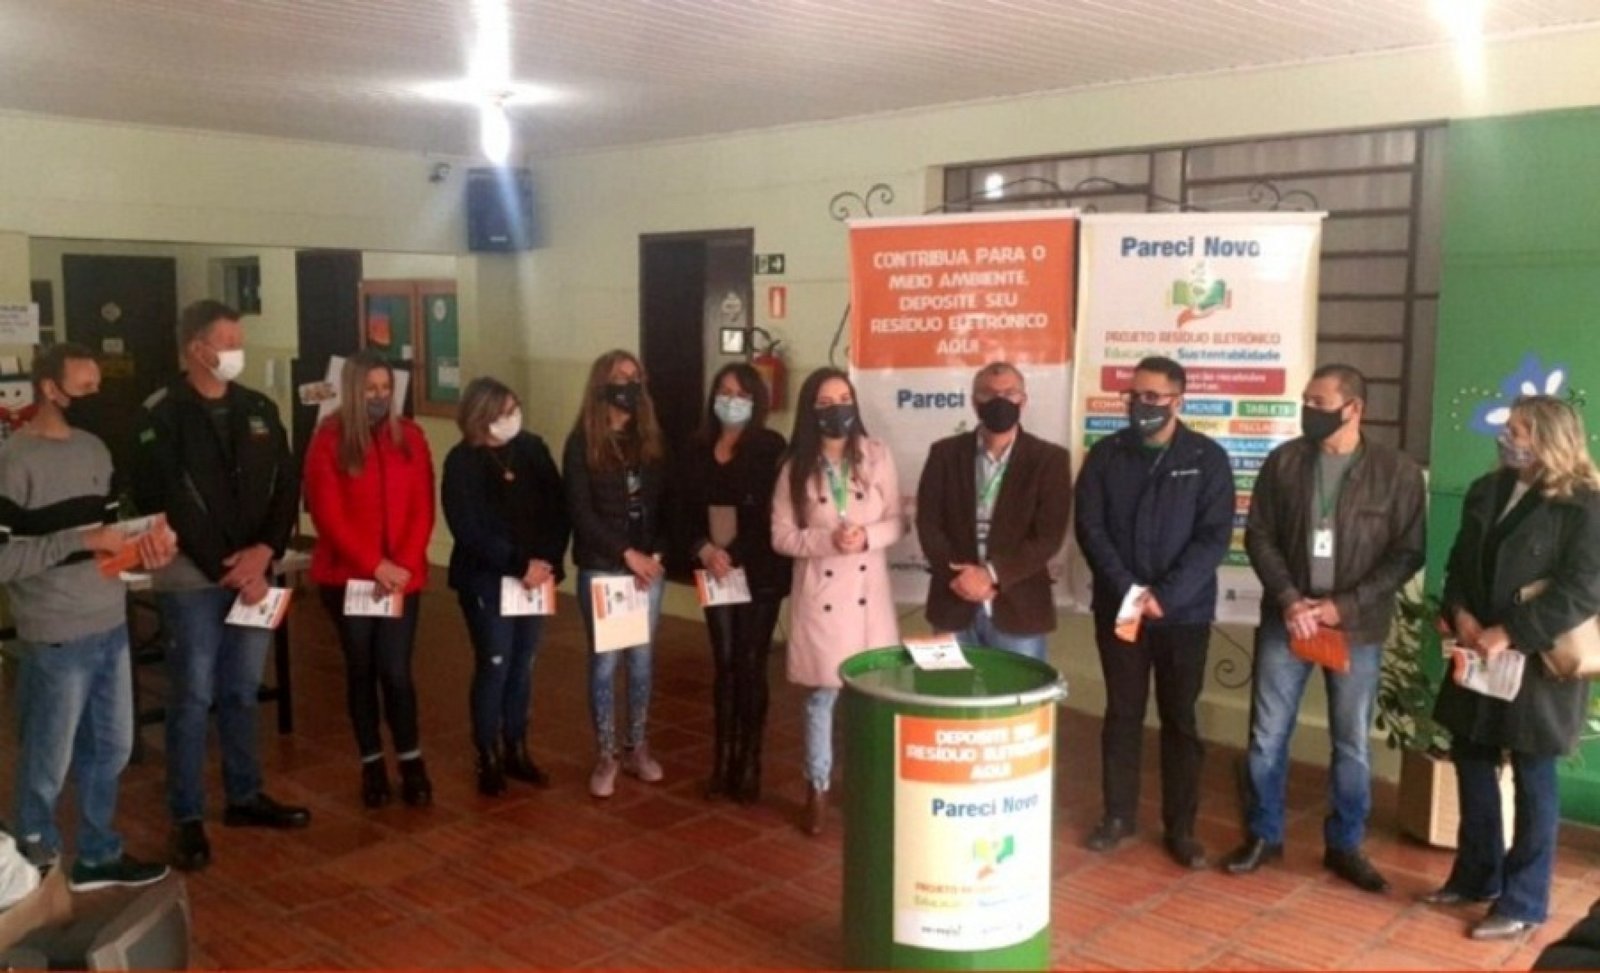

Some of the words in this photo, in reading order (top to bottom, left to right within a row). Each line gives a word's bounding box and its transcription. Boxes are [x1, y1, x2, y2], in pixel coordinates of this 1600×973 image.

[1121, 236, 1194, 257] Pareci
[873, 249, 969, 269] CONTRIBUA
[976, 247, 1026, 265] PARA
[1031, 245, 1047, 262] O
[889, 274, 933, 290] MEIO
[899, 293, 977, 310] DEPOSITE
[986, 292, 1019, 308] SEU
[870, 314, 943, 334] RESÍDUO
[936, 339, 980, 355] AQUI
[897, 388, 965, 409] Pareci
[932, 798, 997, 818] Pareci
